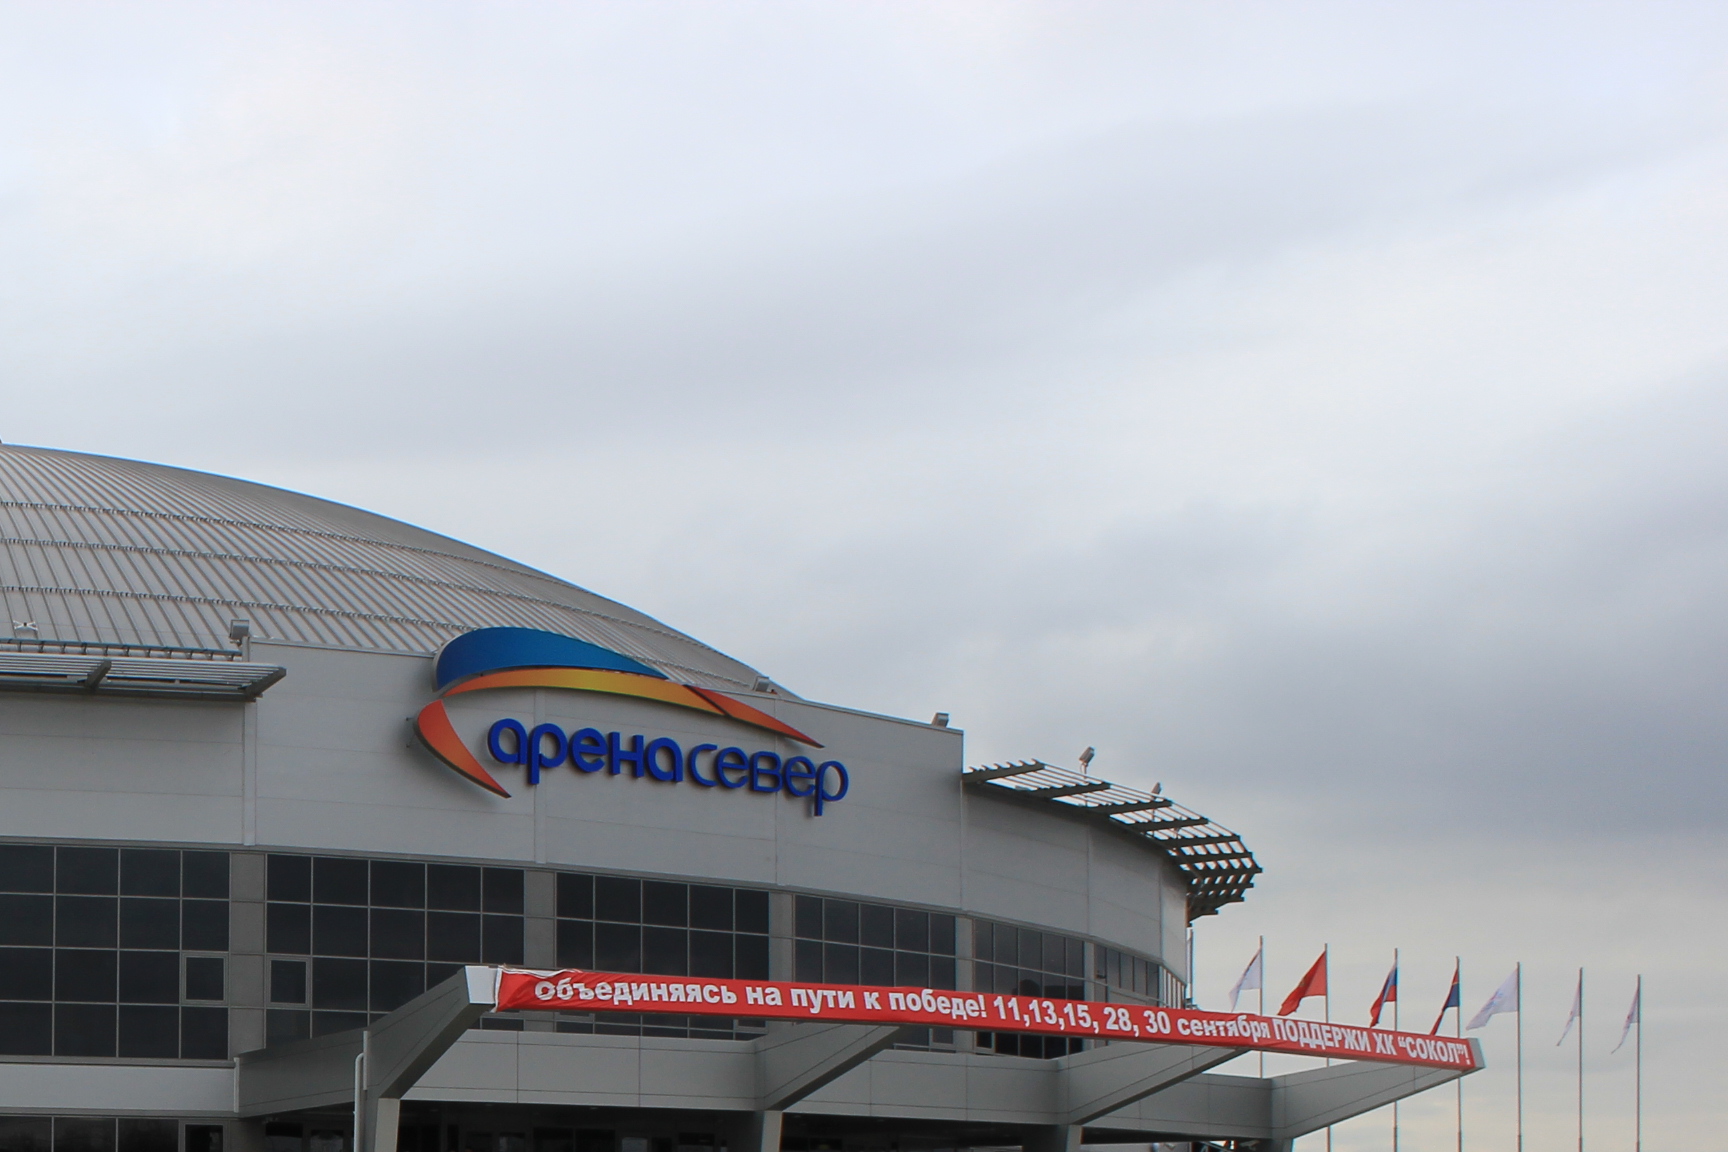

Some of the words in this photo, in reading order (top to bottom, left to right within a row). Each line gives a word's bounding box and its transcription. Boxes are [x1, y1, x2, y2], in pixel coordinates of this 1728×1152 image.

[534, 977, 738, 1006] Объединяясь
[745, 986, 783, 1007] на
[790, 987, 856, 1014] пути
[864, 990, 882, 1010] к
[887, 988, 988, 1021] победе!
[1103, 1006, 1140, 1037] 28,
[1143, 1009, 1172, 1034] 30
[1176, 1014, 1271, 1043] сентября
[1272, 1018, 1372, 1052] ПОДДЕРЖИ
[1372, 1031, 1398, 1056] ХК
